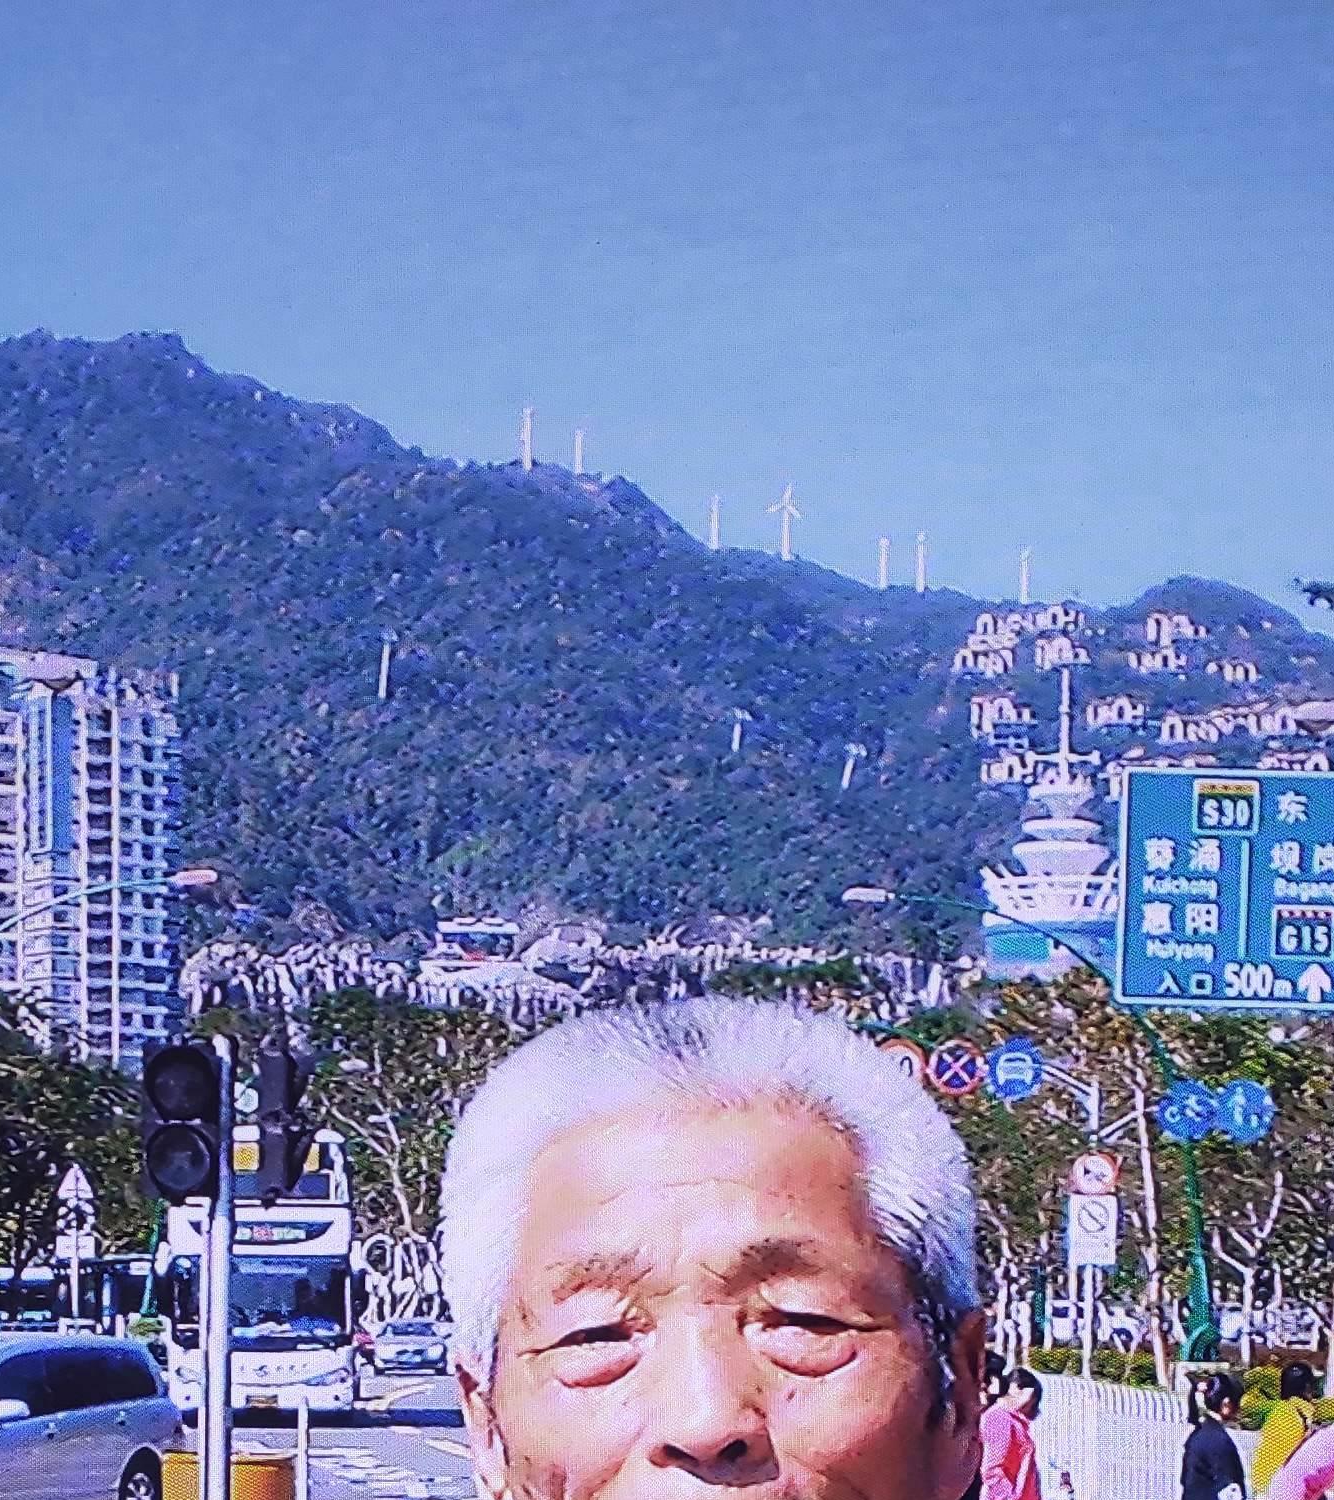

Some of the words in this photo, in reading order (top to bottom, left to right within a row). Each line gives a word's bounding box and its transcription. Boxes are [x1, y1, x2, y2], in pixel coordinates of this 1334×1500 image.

[1202, 798, 1250, 826] S30
[1277, 790, 1308, 824] 东
[1280, 924, 1329, 952] G15
[1158, 970, 1214, 996] 入口
[1224, 962, 1293, 998] 500m
